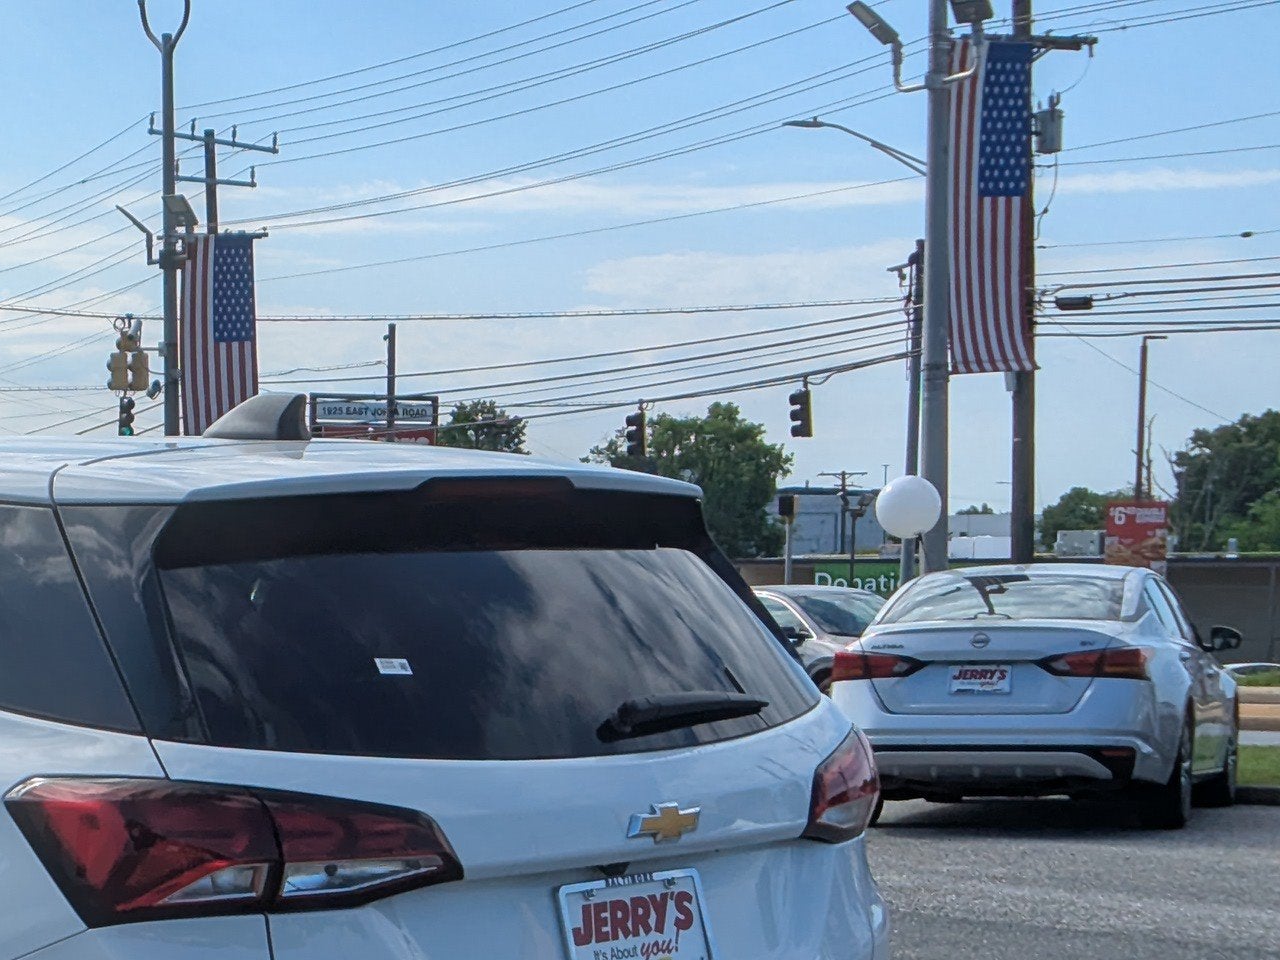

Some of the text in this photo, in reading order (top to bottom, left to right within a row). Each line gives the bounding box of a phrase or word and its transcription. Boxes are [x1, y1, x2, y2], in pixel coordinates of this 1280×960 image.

[345, 406, 369, 416] EAST
[371, 407, 399, 417] JOA
[402, 408, 427, 418] ROAD
[952, 668, 1008, 681] JERRY'S
[572, 891, 694, 947] JERRY'S
